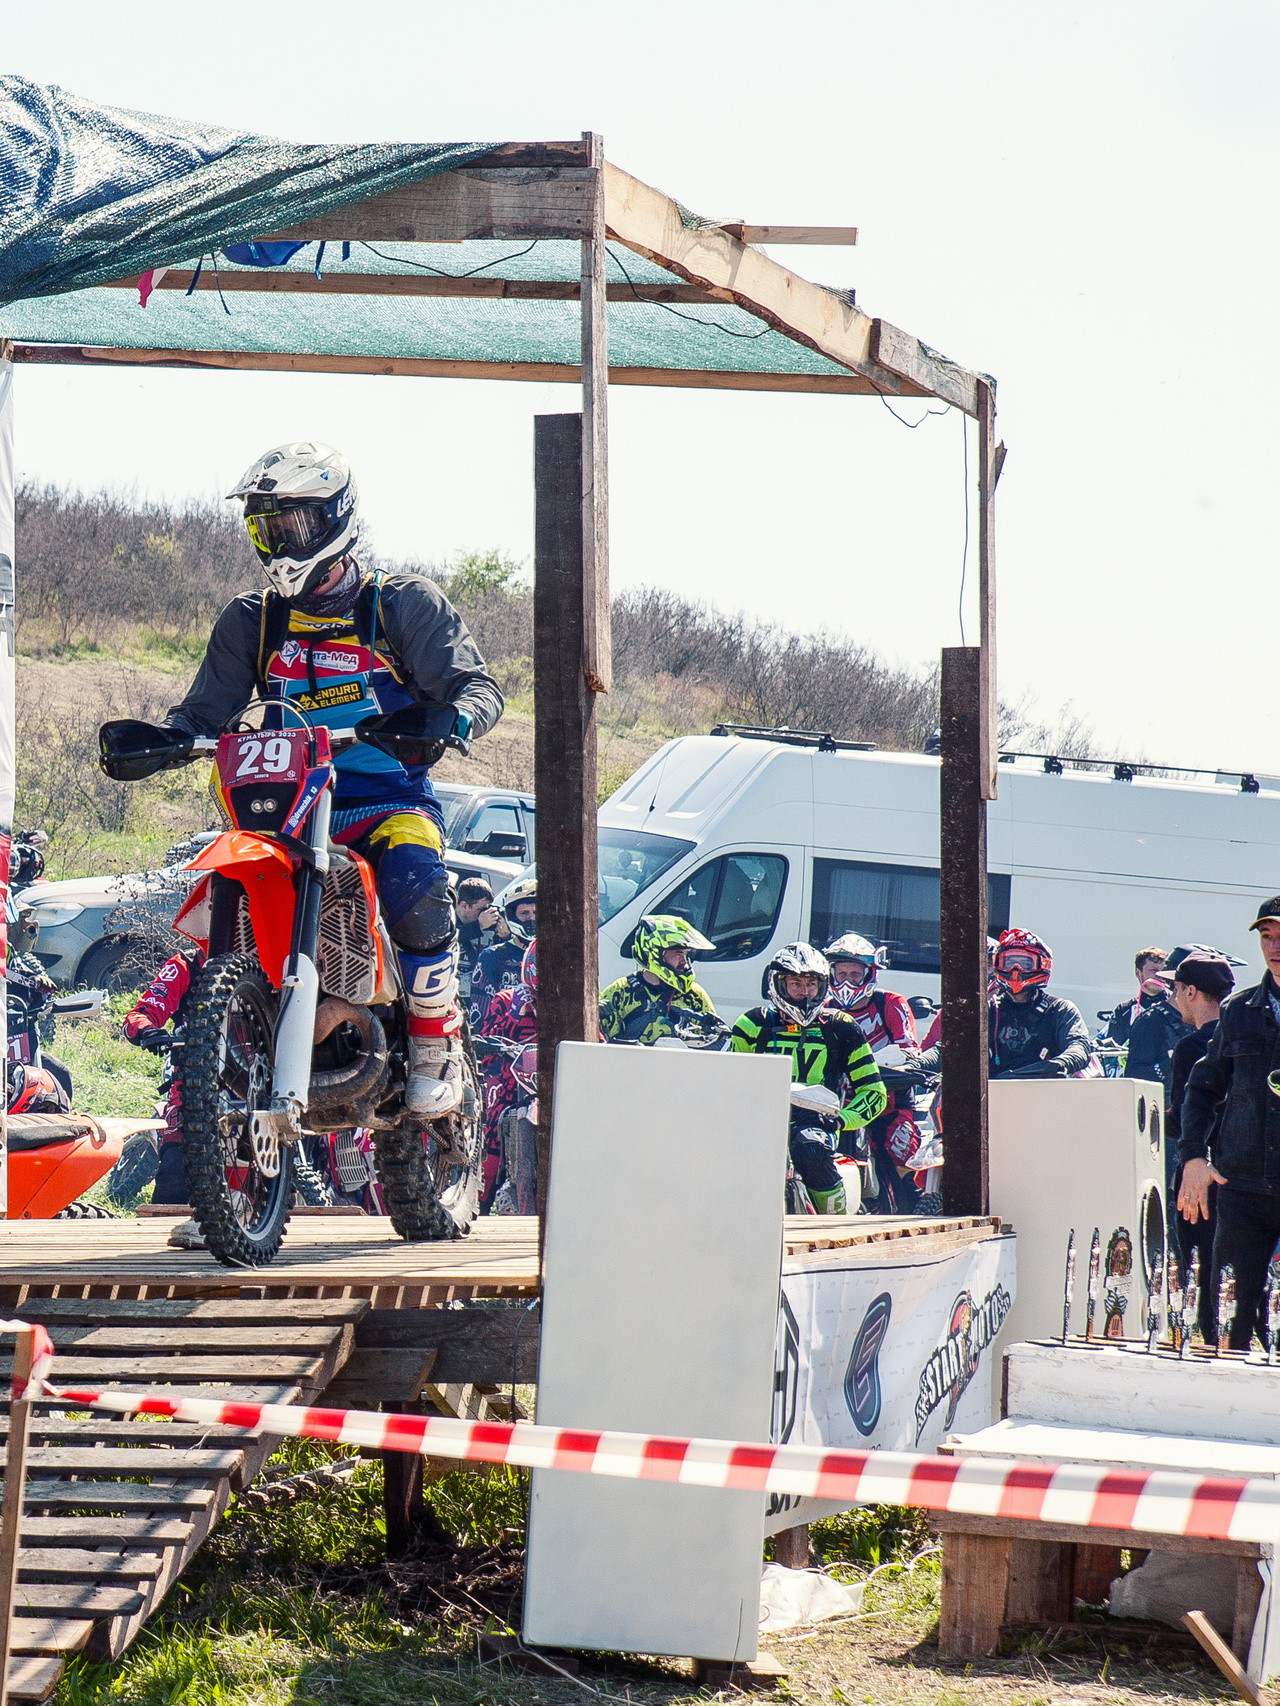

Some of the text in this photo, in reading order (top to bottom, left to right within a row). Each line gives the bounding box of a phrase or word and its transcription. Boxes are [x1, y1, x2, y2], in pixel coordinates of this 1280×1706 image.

[315, 683, 359, 700] ENDURO
[320, 693, 361, 707] ELEMENT
[237, 732, 276, 743] КУМАТЫРЬ
[236, 738, 292, 777] 29
[926, 1333, 965, 1404] START
